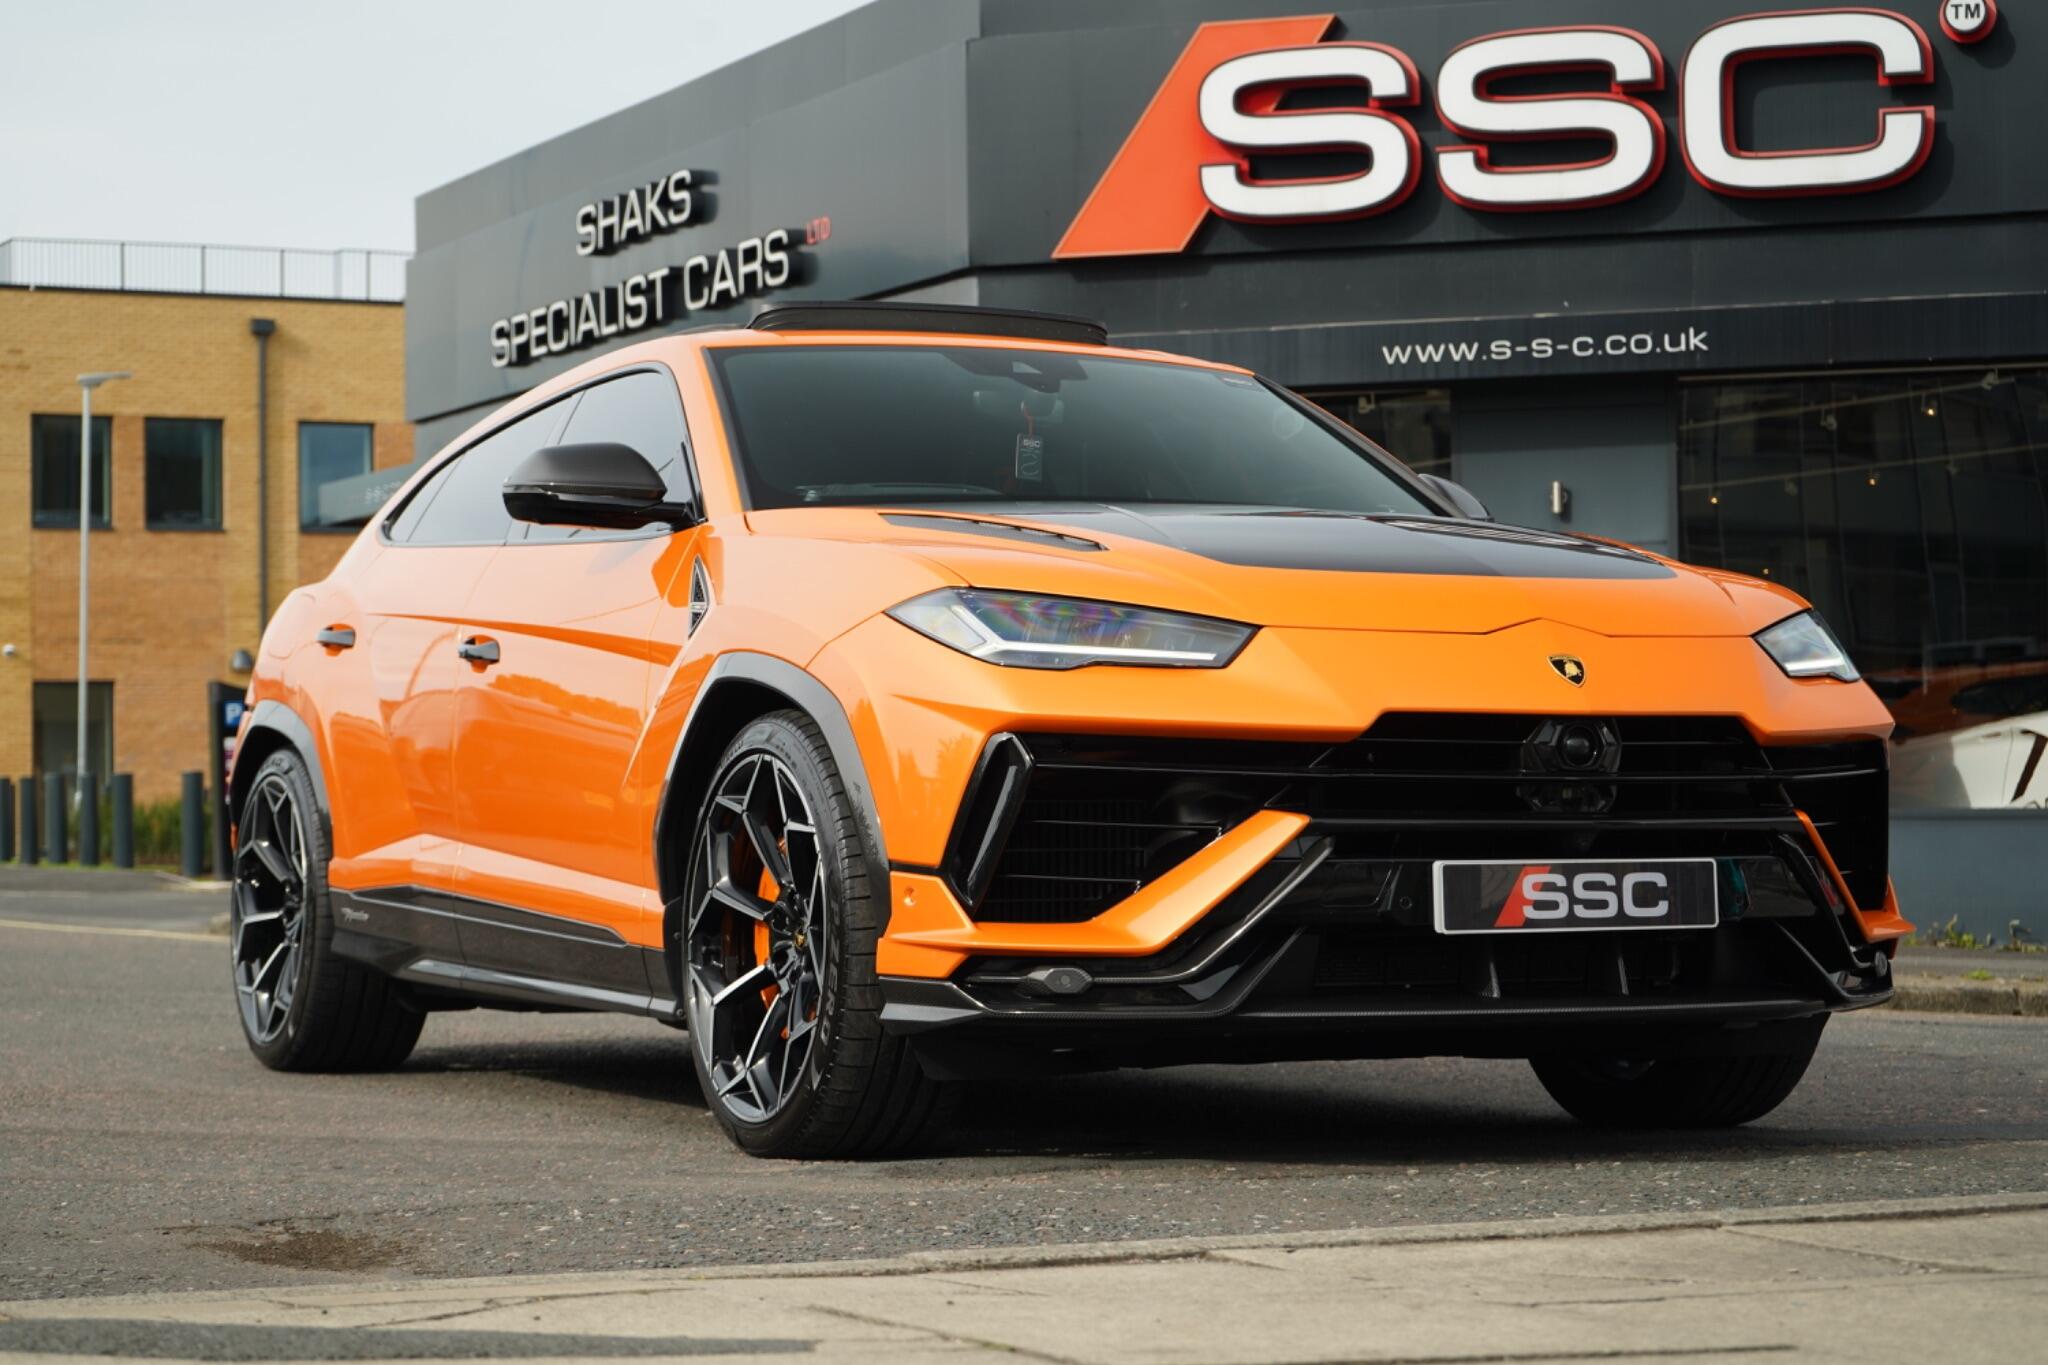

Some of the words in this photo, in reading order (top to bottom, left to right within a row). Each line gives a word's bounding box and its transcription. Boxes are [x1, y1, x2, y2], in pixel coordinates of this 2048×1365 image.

[1199, 8, 1935, 222] SSC
[1950, 3, 1981, 19] TM
[575, 169, 692, 256] SHAKS
[490, 268, 669, 367] SPECIALIST
[683, 229, 790, 311] CARS
[806, 217, 831, 245] LTD
[1382, 327, 1709, 365] www.s-s-c.co.uk
[1522, 871, 1669, 920] SSC
